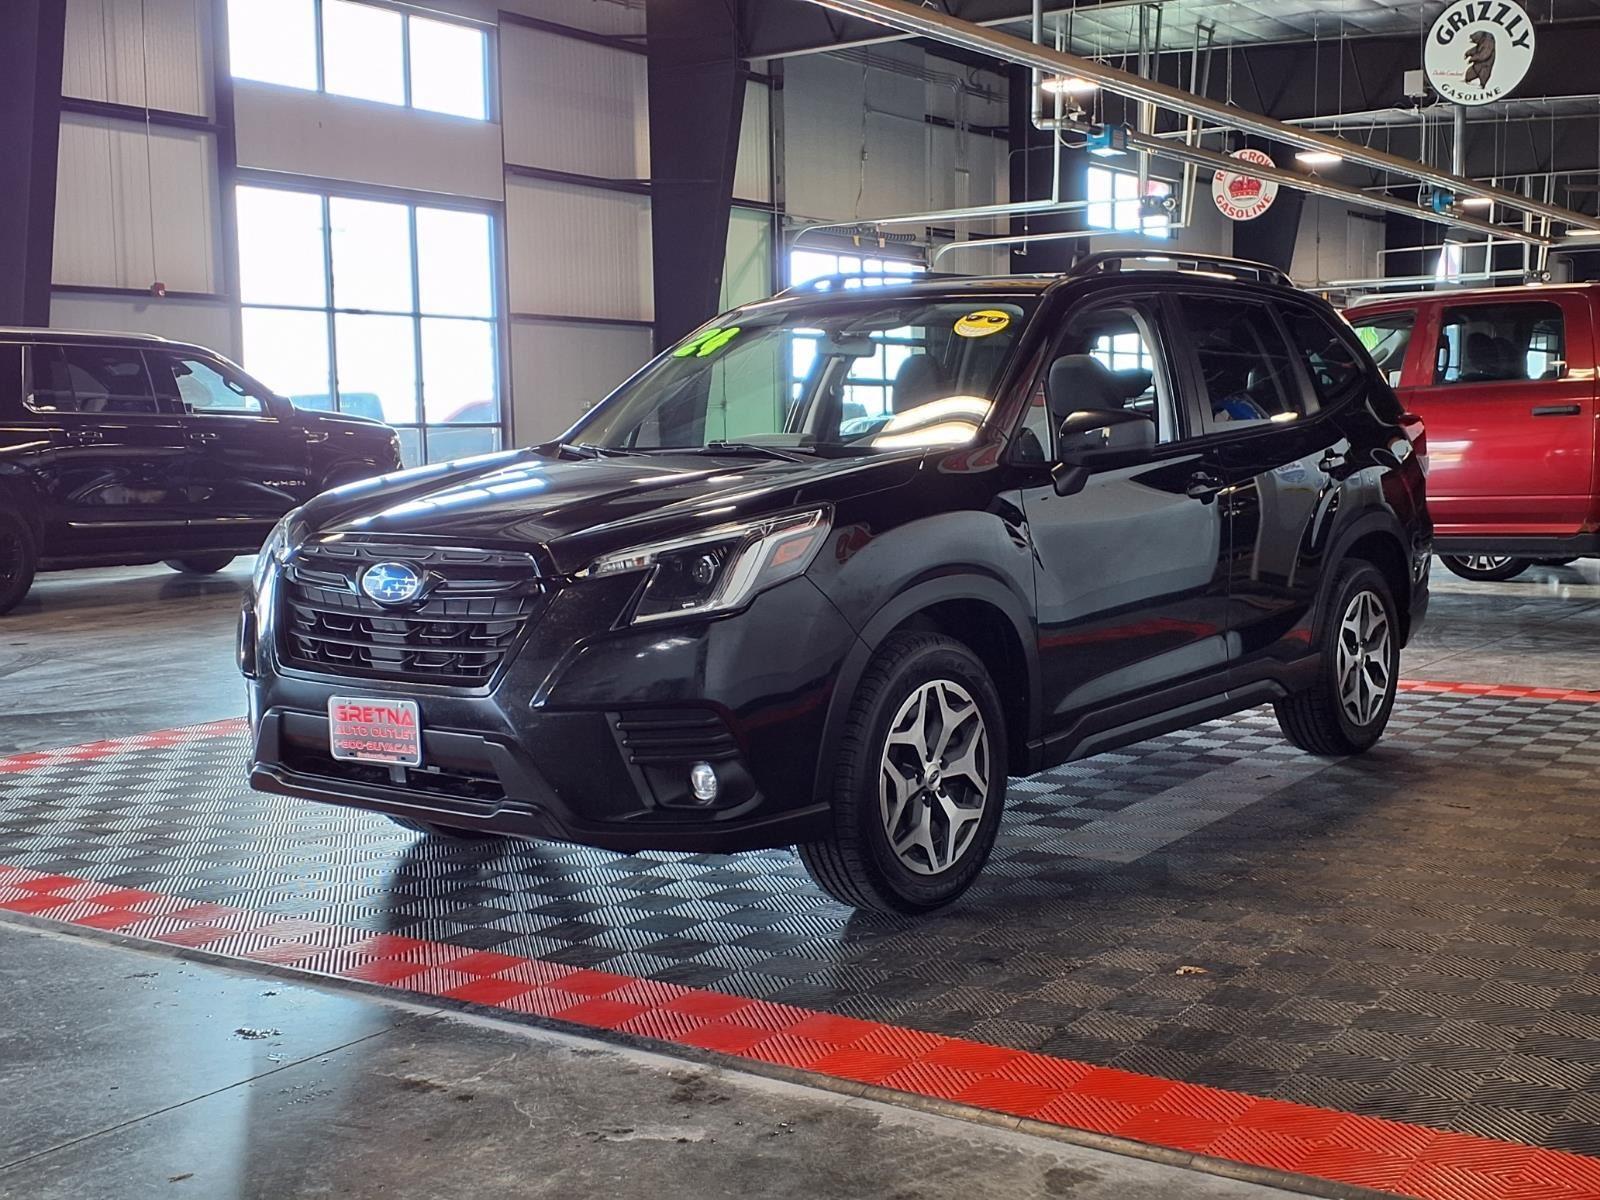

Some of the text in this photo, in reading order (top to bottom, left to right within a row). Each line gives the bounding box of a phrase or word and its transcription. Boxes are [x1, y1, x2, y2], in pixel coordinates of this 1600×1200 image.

[1436, 1, 1530, 50] GRIZZLY
[1441, 83, 1502, 101] GASOLINE
[1215, 194, 1273, 218] GASOLINE
[335, 705, 415, 727] GRETNA
[335, 725, 416, 740] AUTO OUTLET
